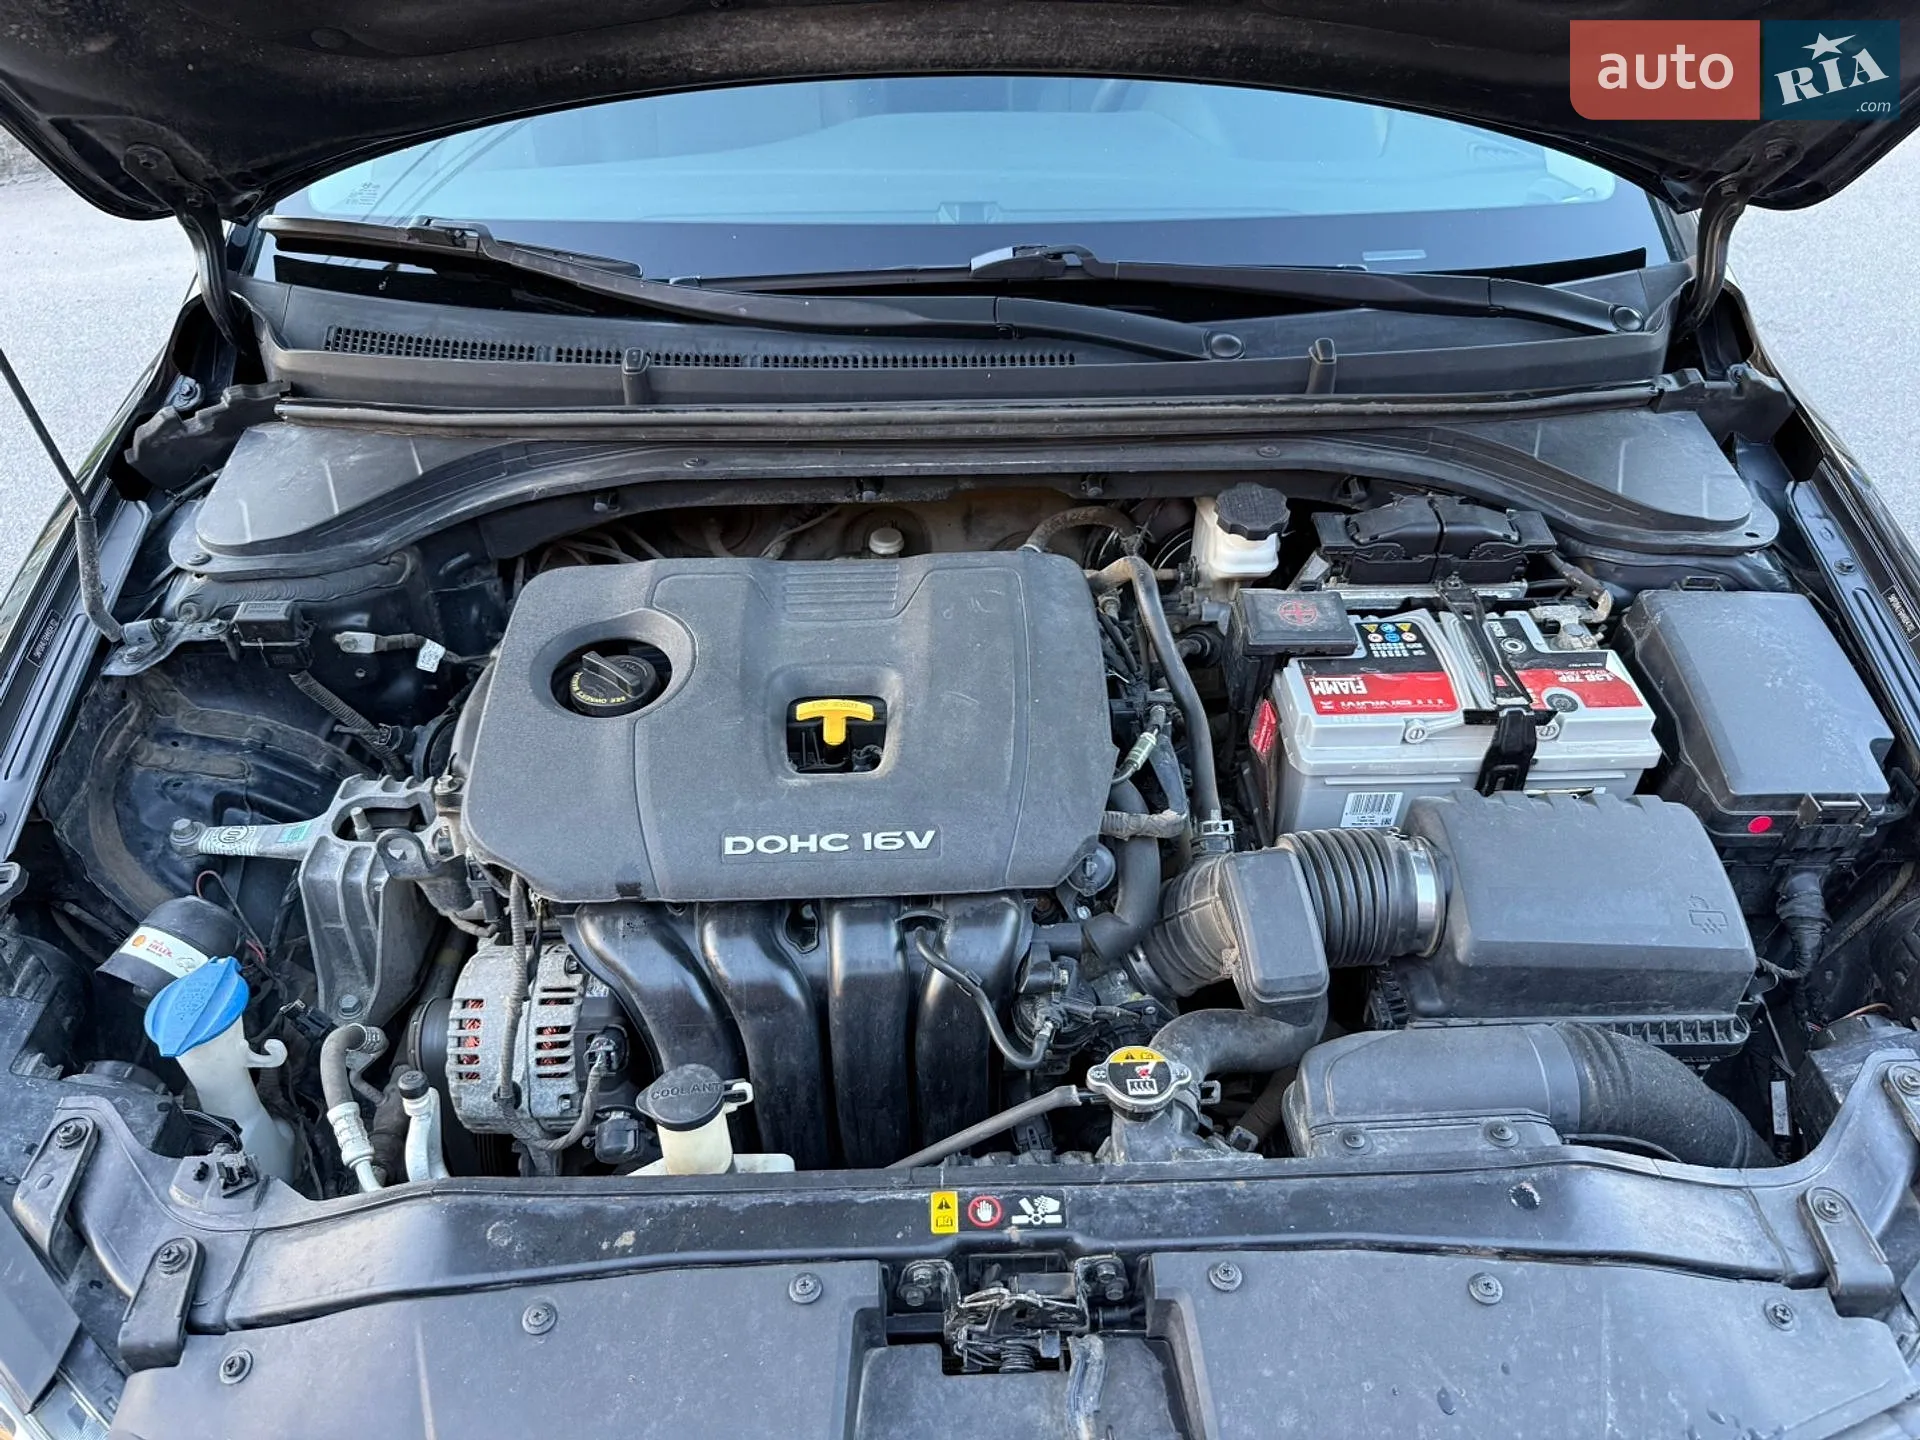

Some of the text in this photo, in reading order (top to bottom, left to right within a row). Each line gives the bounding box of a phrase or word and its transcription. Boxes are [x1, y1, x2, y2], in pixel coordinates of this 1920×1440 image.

[1309, 680, 1368, 695] FIAMM
[724, 830, 936, 855] DOHC 16V
[651, 1081, 721, 1100] COOLANT
